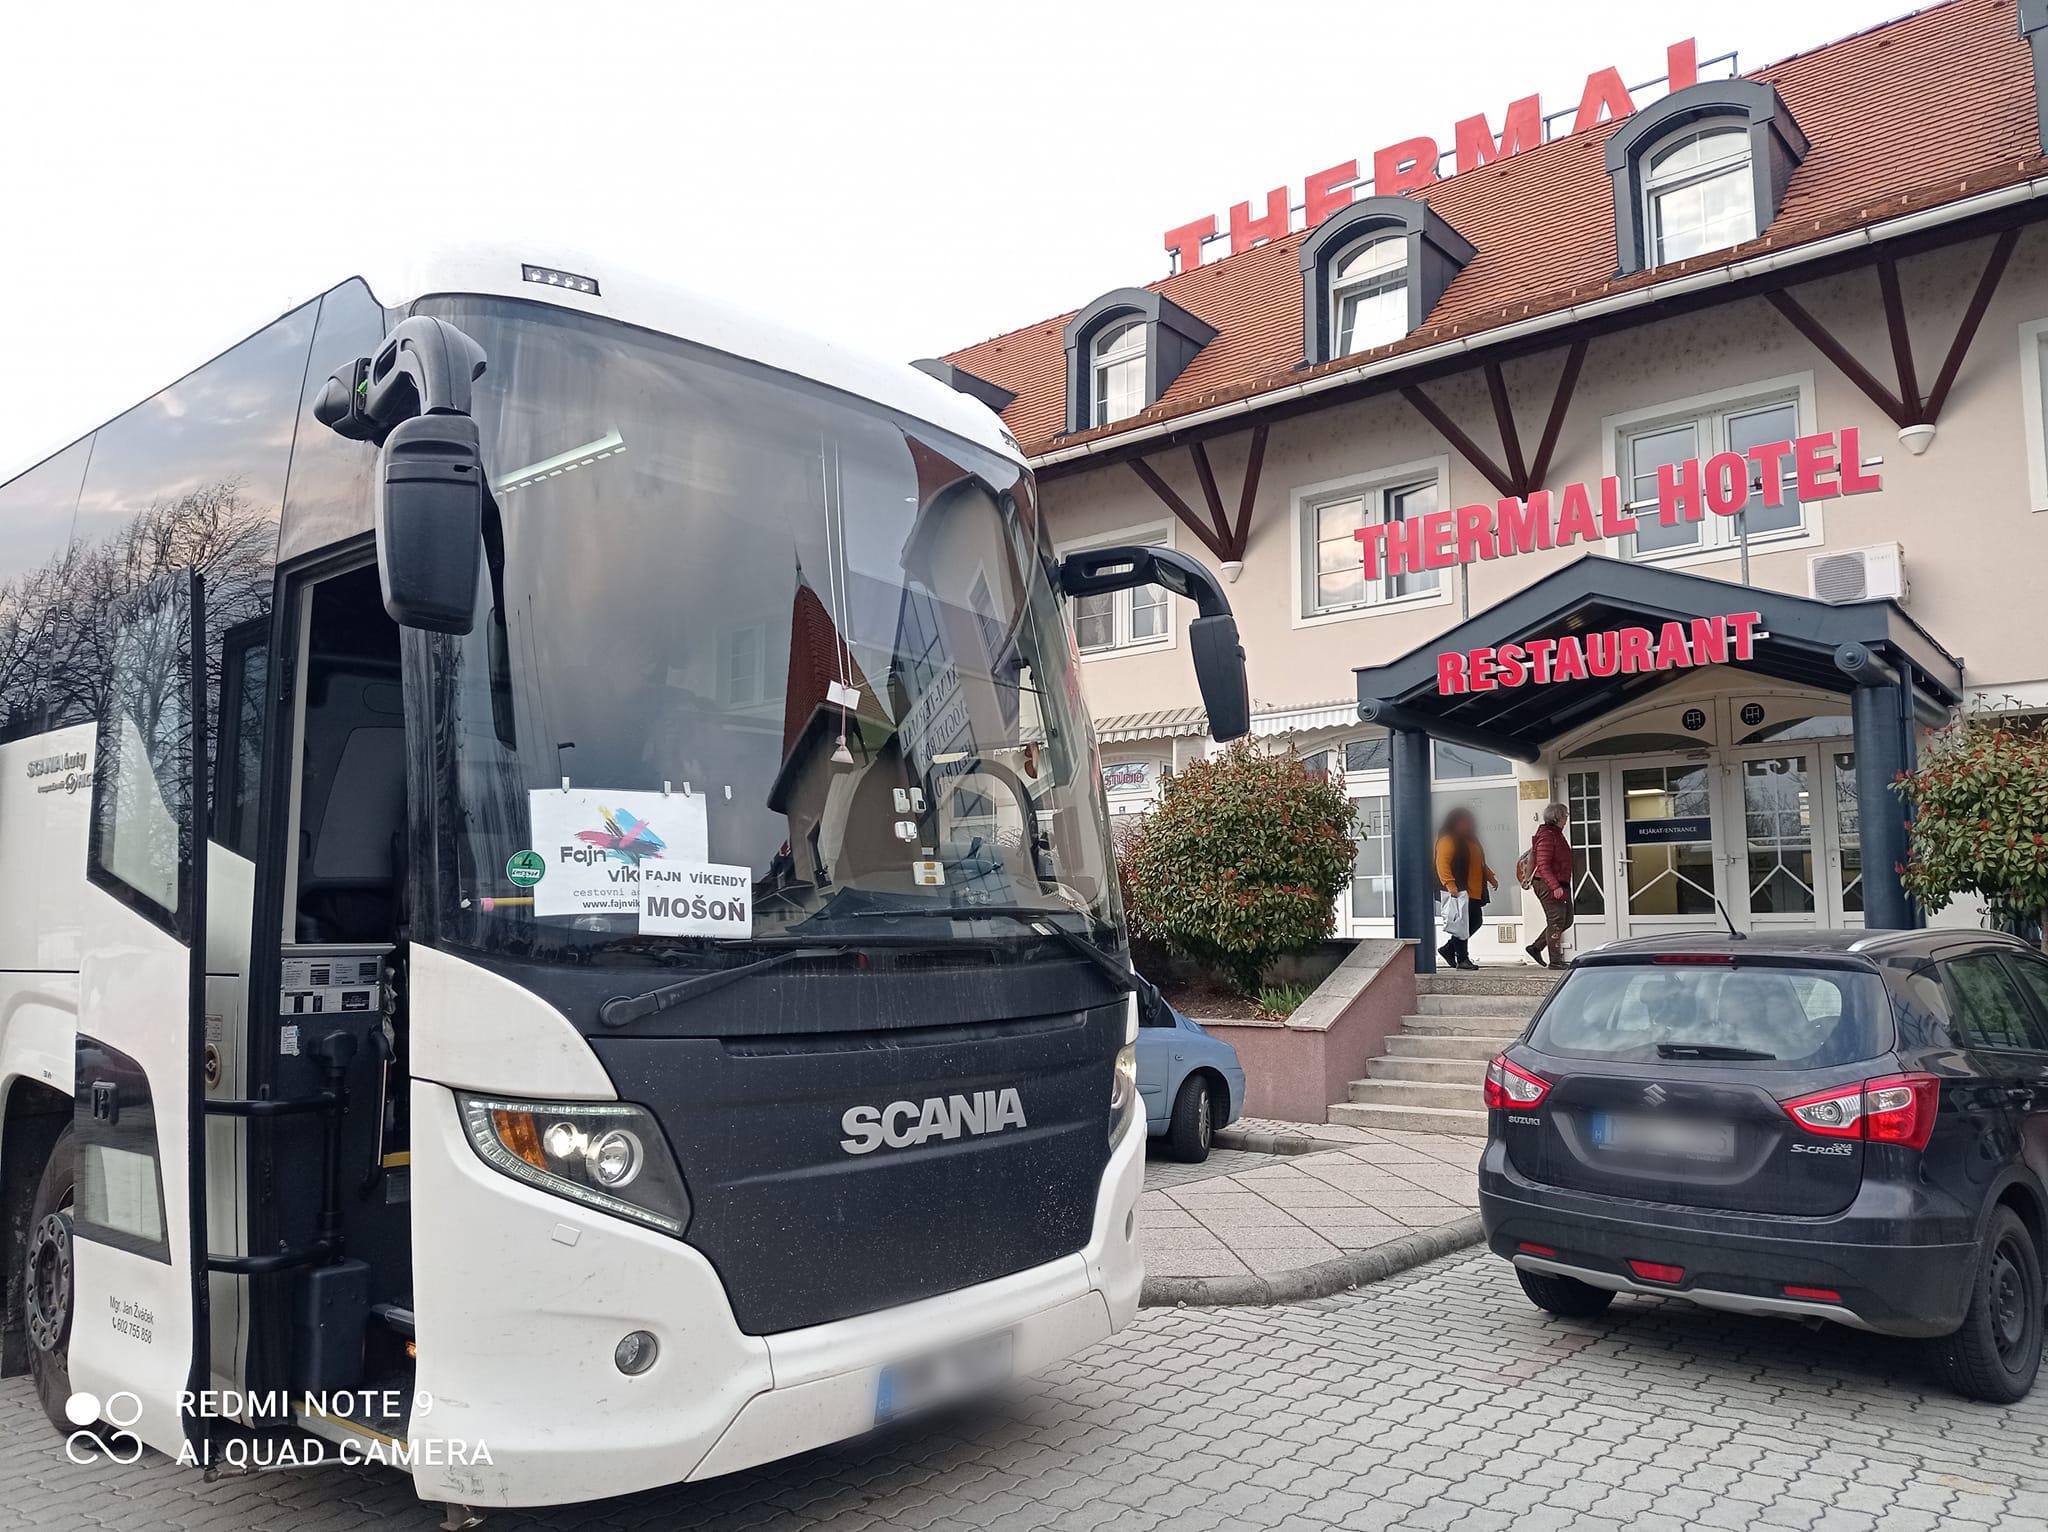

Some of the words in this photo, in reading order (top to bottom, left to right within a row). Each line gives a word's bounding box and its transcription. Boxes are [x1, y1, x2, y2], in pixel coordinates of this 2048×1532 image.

[1354, 475, 1640, 581] THERMAL
[1657, 426, 1884, 528] HOTEL
[1437, 611, 1762, 696] RESTAURANT
[521, 852, 533, 869] 4
[560, 845, 607, 867] Fajn
[645, 869, 682, 883] FAJN
[689, 870, 747, 888] VÍKENDY
[647, 894, 746, 922] MOŠOŇ
[840, 1087, 1028, 1155] SCANIA
[1508, 1115, 1541, 1126] SUZUKI
[1790, 1143, 1853, 1156] S-CROSS
[1832, 1142, 1853, 1150] SX4
[109, 1295, 122, 1314] Mgr.
[122, 1301, 133, 1316] Jan
[117, 1318, 128, 1334] 602
[129, 1322, 141, 1339] 755
